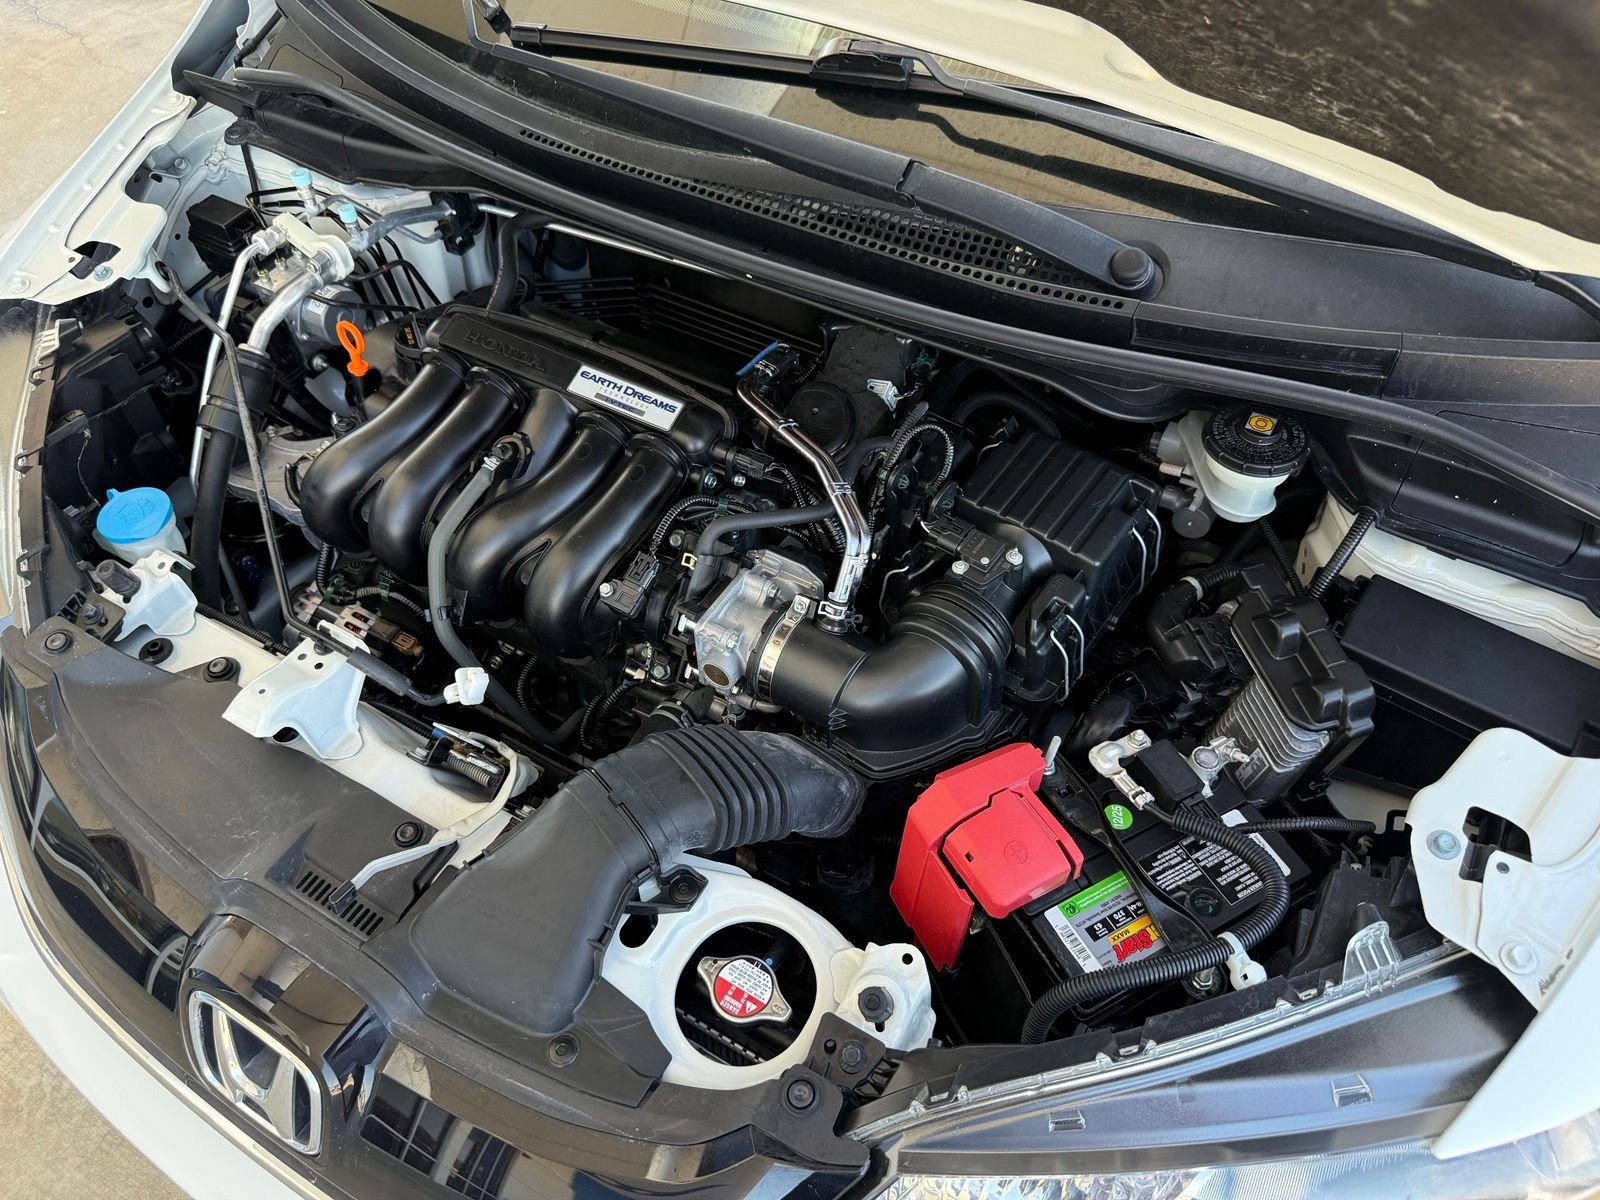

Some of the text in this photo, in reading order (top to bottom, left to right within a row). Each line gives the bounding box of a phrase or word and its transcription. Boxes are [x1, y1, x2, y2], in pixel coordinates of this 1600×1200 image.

[463, 329, 545, 372] HONDA
[580, 370, 678, 414] EARTH DREAMS
[1113, 909, 1126, 920] 370
[1111, 928, 1131, 943] MAXX
